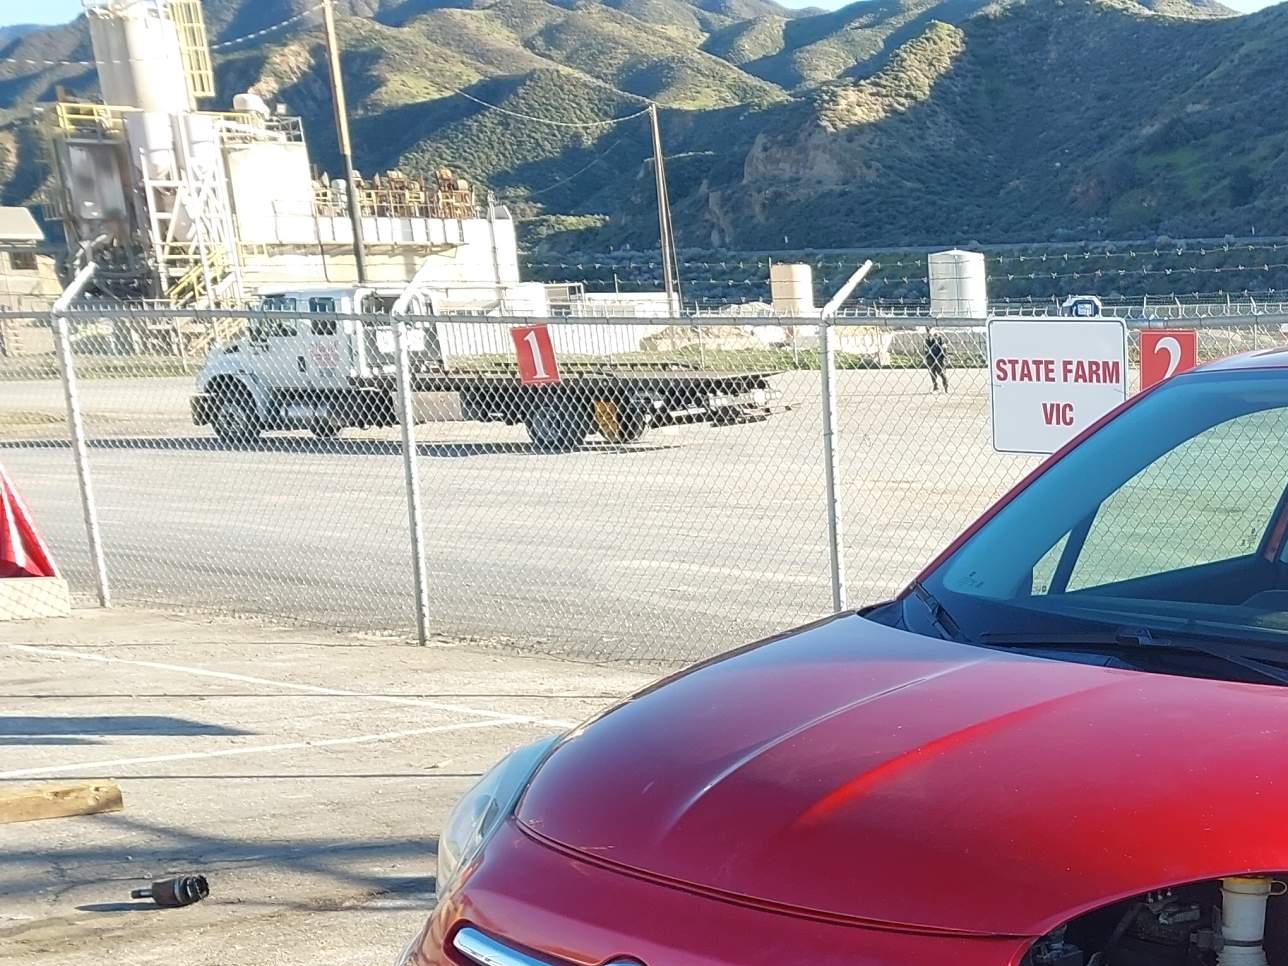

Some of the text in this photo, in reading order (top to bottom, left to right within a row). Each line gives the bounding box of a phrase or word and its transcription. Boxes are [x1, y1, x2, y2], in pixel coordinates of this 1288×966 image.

[523, 329, 551, 379] 1
[995, 358, 1120, 385] STATE FARM
[1042, 402, 1074, 426] VIC
